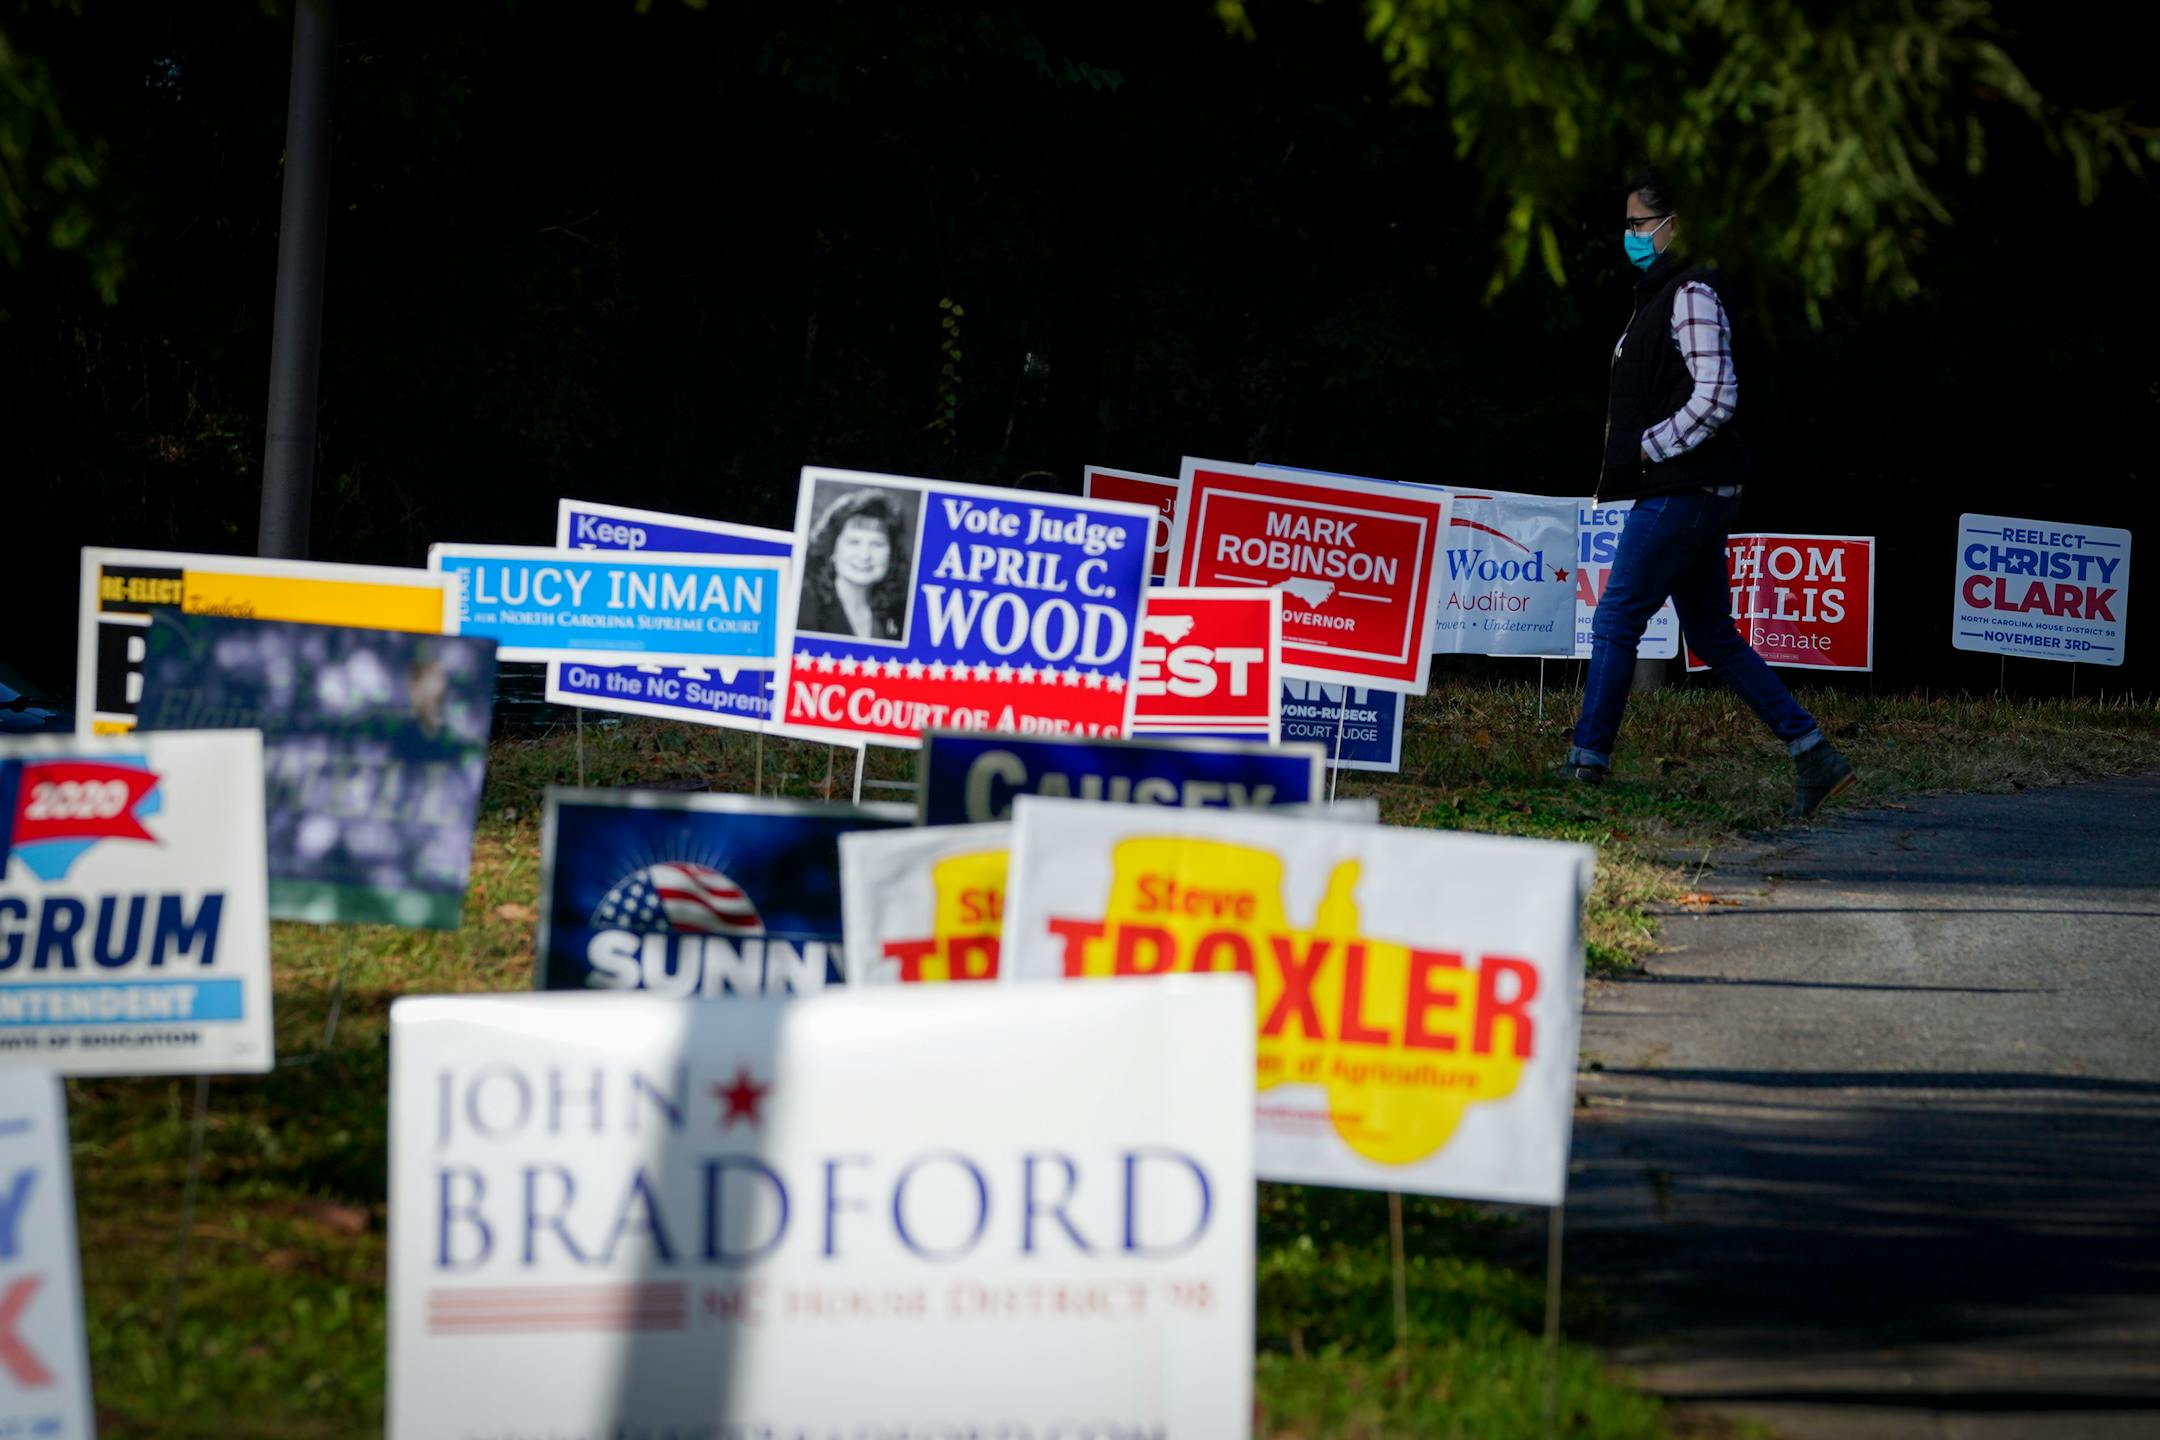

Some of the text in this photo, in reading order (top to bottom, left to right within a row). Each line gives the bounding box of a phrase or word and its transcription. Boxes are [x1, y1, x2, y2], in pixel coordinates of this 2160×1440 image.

[577, 514, 647, 552] Keep
[942, 497, 1020, 536] Vote
[1024, 509, 1126, 556] Judge
[1265, 511, 1358, 549] MARK
[2002, 527, 2086, 549] REELECT
[932, 541, 1117, 600] APRIL C.
[1216, 532, 1399, 586] ROBINSON
[1446, 549, 1545, 582] Wood
[1724, 545, 1847, 582] HOM
[1963, 543, 2121, 584] CHRISTY
[101, 575, 182, 604] RE-ELECT
[475, 566, 764, 615] LUCY INMAN
[1446, 591, 1531, 612] Auditor
[1728, 584, 1846, 624] ILLIS
[1962, 574, 2118, 623] CLARK
[500, 610, 555, 626] NORTH
[557, 612, 634, 629] CAROLINA
[637, 614, 704, 633] SUPREME
[707, 617, 761, 635] COURT
[922, 583, 1128, 667] WOOD
[1282, 609, 1356, 632] OVERNOR
[1483, 618, 1555, 633] Undeterred
[1752, 626, 1832, 651] Senate
[1961, 615, 2116, 638] NORTH CAROLINA HOUSE DISTRICT 98
[1984, 630, 2062, 649] NOVEMBER
[2064, 639, 2092, 652] 3RD
[568, 667, 602, 690] On
[606, 672, 643, 694] the
[647, 677, 681, 700] NC
[1138, 645, 1264, 698] EST
[789, 680, 846, 720] NC
[847, 687, 949, 730] COURT
[1281, 703, 1378, 723] VONG-RUBECK
[1288, 723, 1333, 739] COURT
[1334, 728, 1378, 742] JUDGE
[26, 780, 130, 821] 2020
[1136, 872, 1258, 922] Steve
[0, 893, 225, 971] GRUM
[585, 928, 845, 999] SUNN
[437, 1063, 690, 1147] JOHN
[432, 1147, 1217, 1271] BRADFORD
